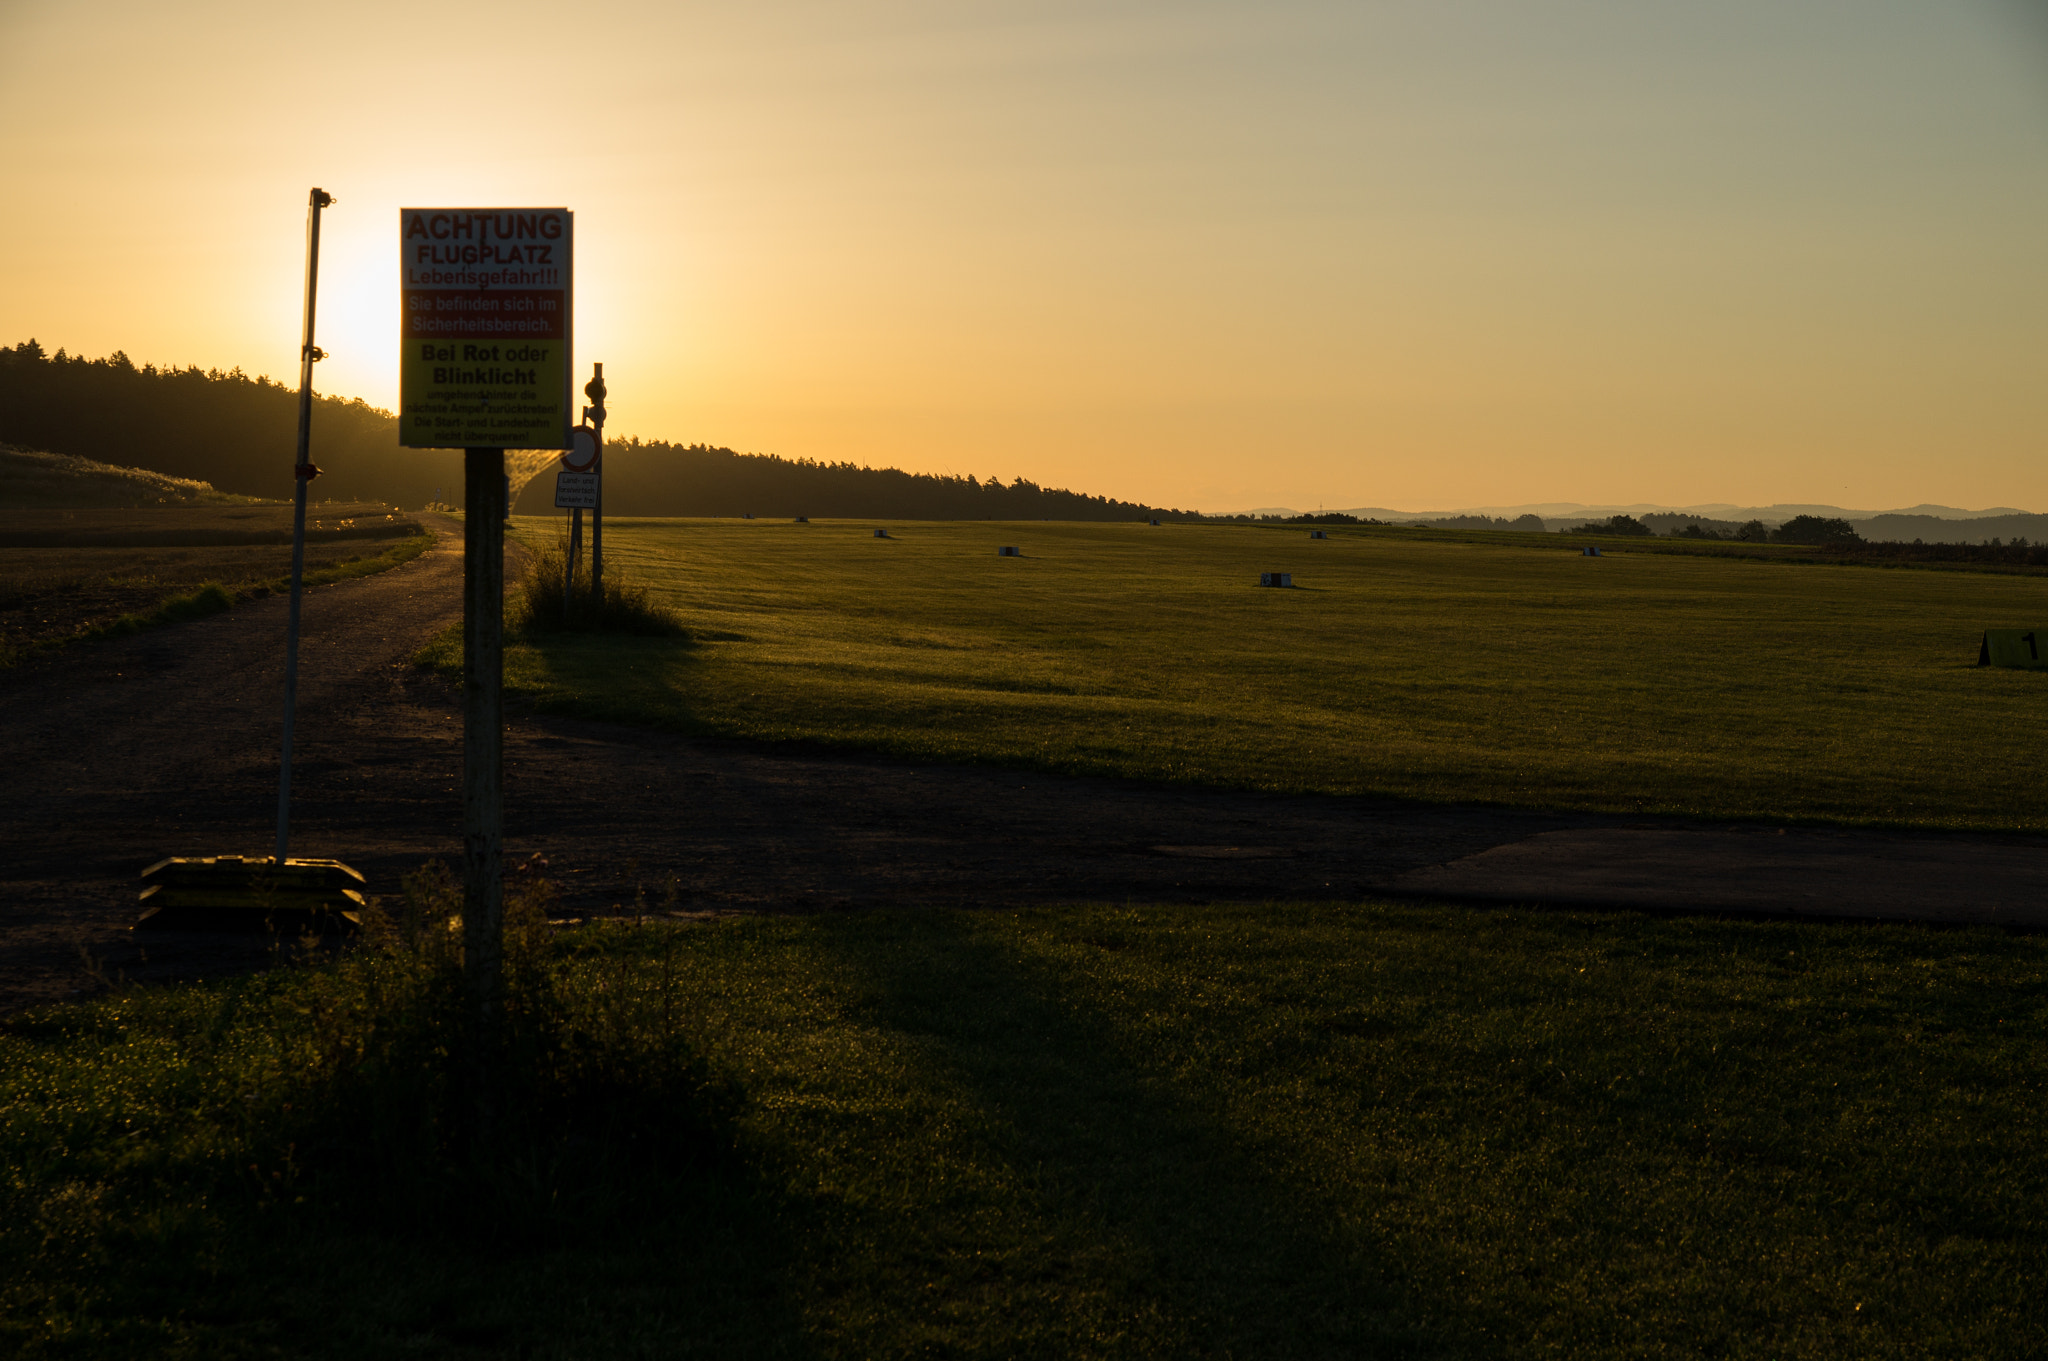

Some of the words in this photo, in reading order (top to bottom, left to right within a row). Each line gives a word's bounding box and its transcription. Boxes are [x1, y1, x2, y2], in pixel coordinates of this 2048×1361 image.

[407, 214, 561, 239] ACHTUNG
[417, 245, 551, 264] FLUGPLATZ
[409, 269, 558, 287] Lebensgefahr!!!
[409, 297, 431, 311] Sie
[436, 296, 499, 311] befinden
[504, 297, 533, 311] sich
[539, 298, 556, 310] im
[412, 317, 552, 332] Sicherheitsbereich.
[422, 346, 455, 361] Bei
[464, 346, 499, 361] Rot
[506, 346, 548, 361] oder
[434, 368, 536, 384] Blinklicht
[521, 390, 536, 400] die
[414, 417, 431, 427] Die
[467, 418, 486, 428] und
[491, 418, 549, 428] Landebahn
[435, 431, 460, 441] nicht
